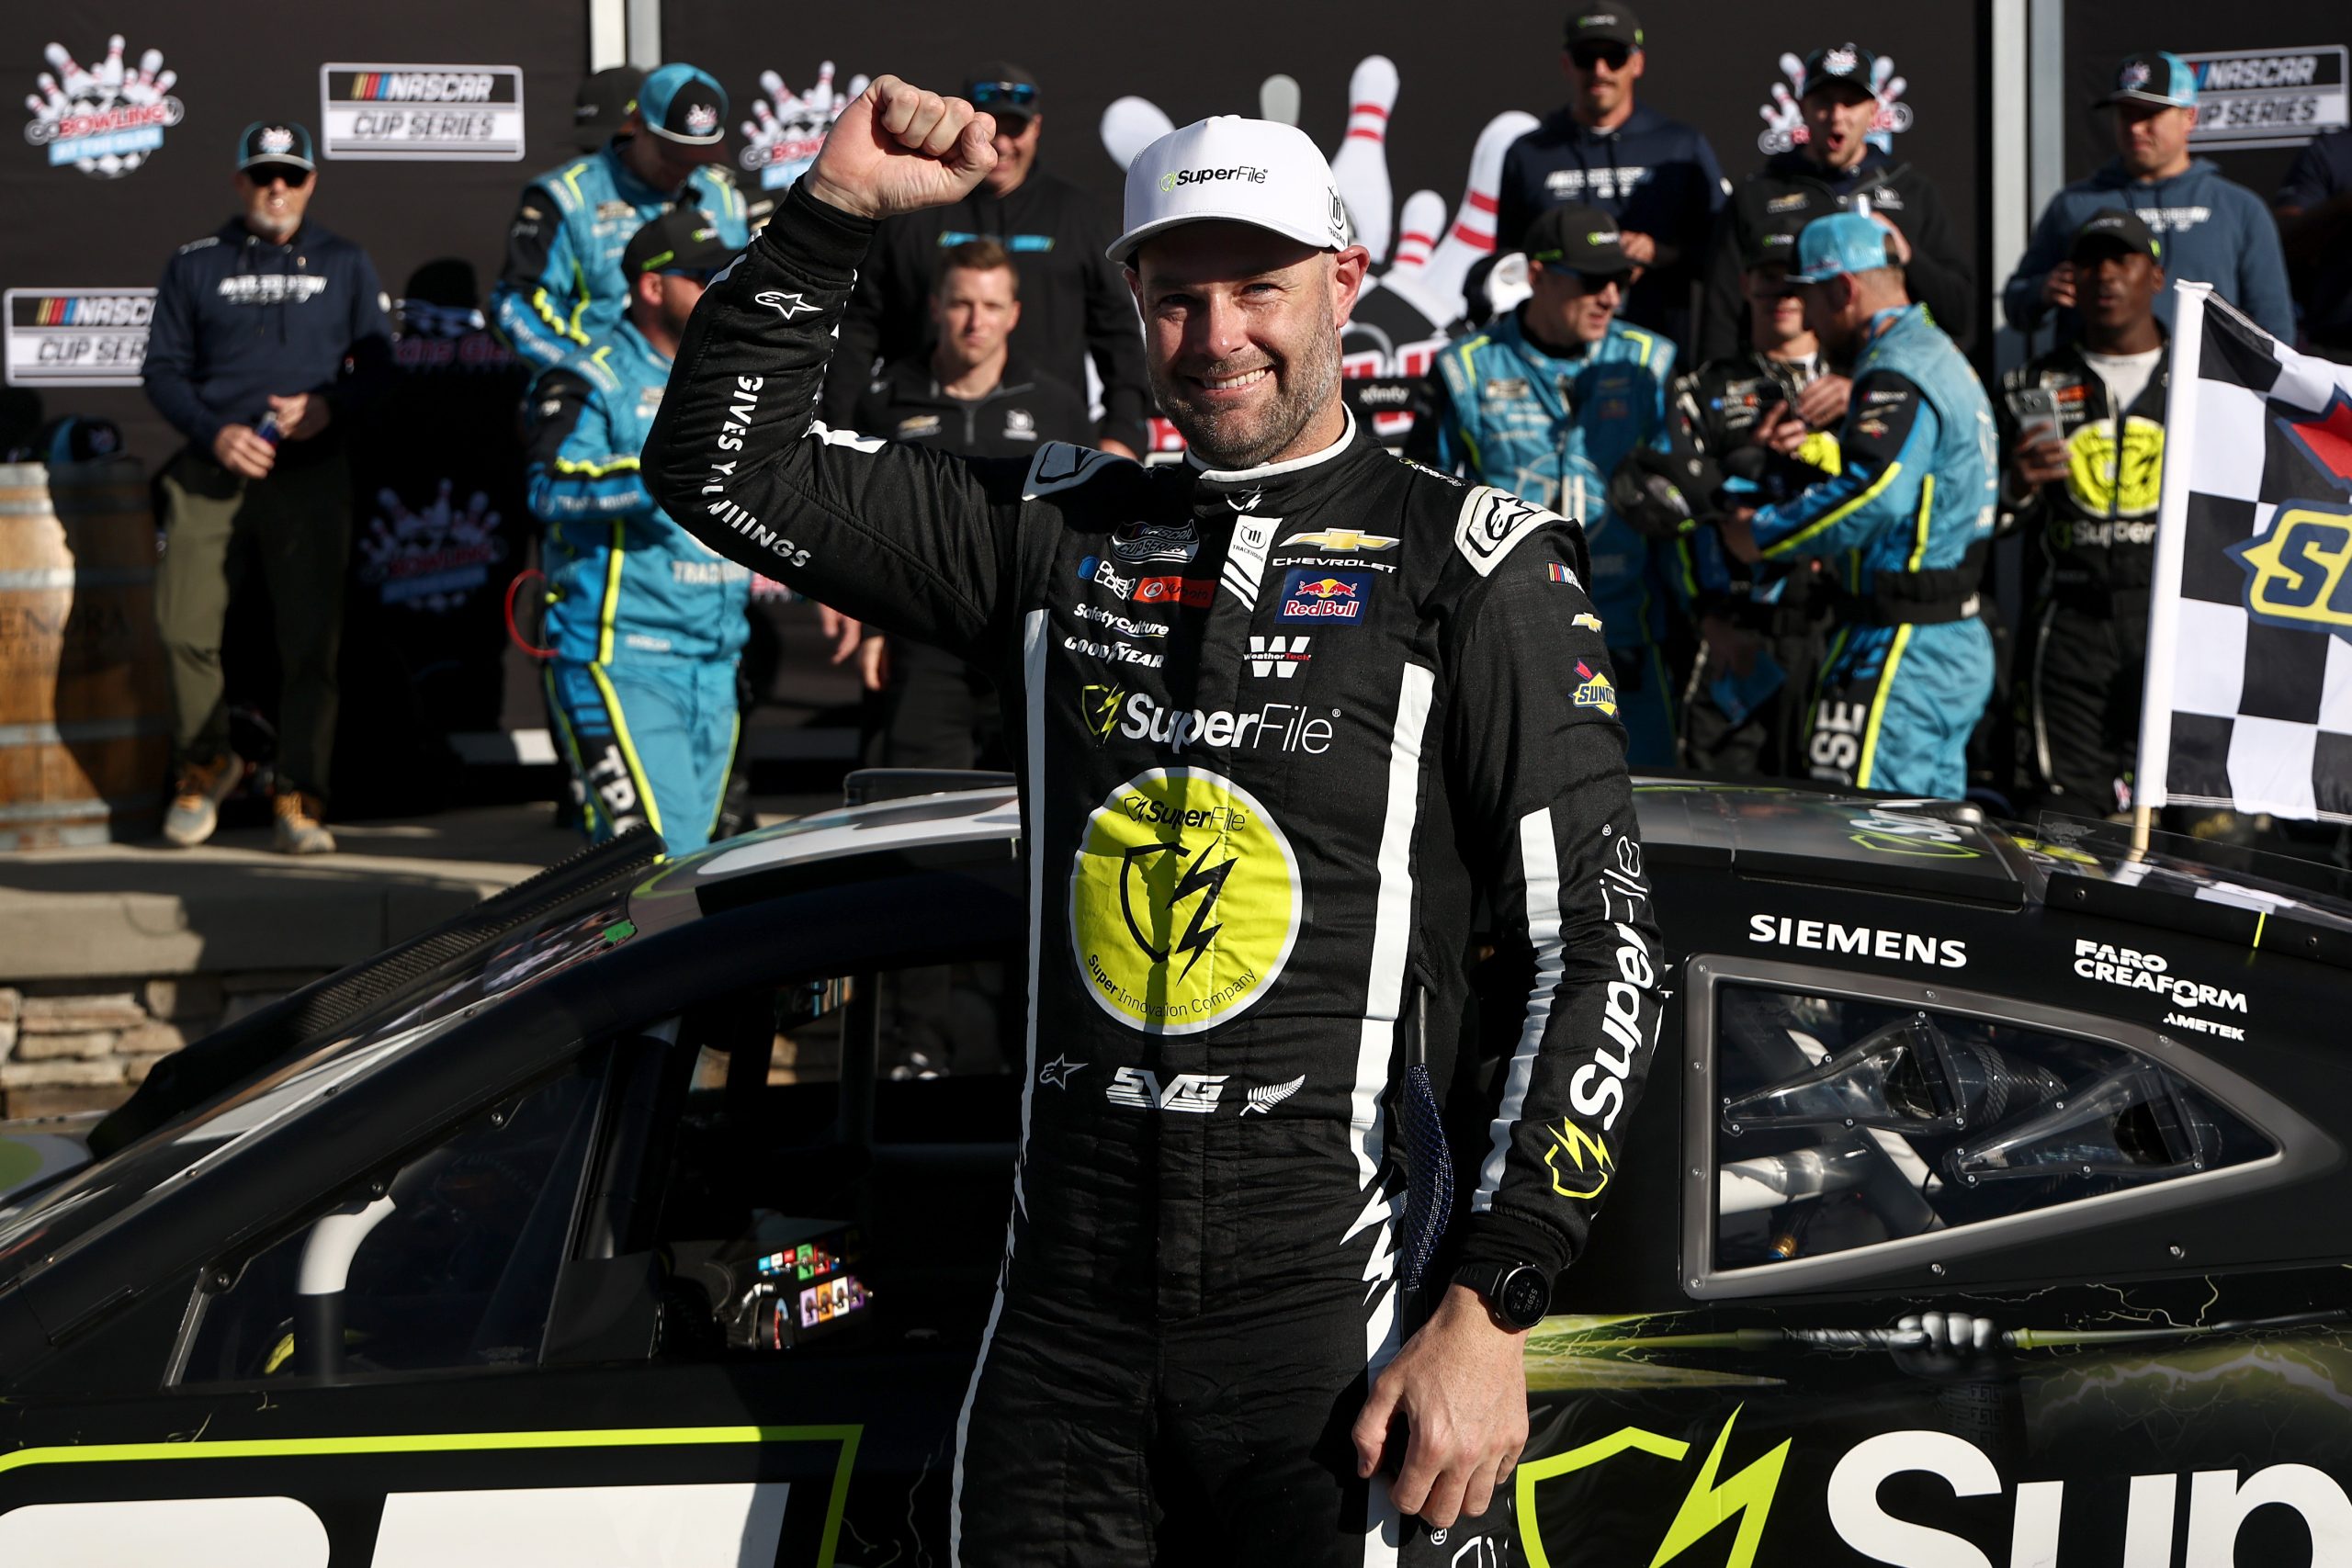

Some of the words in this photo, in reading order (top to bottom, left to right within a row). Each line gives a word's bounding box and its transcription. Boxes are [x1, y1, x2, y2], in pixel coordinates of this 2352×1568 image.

[390, 73, 493, 101] NASCAR
[2204, 57, 2317, 89] NASCAR
[59, 103, 165, 138] BOWLING
[353, 112, 404, 138] CUP
[409, 113, 494, 140] SERIES
[2227, 97, 2316, 127] SERIES
[772, 134, 826, 164] BOW
[1177, 165, 1266, 186] SuperFile
[74, 297, 156, 326] NASC
[39, 337, 90, 363] CUP
[96, 337, 151, 363] SER
[718, 373, 764, 452] GIVES
[702, 460, 737, 496] YU
[1117, 543, 1143, 556] CUP
[1143, 540, 1188, 553] SERIES
[1140, 525, 1193, 540] NASCAR
[2073, 520, 2157, 548] Super
[1272, 557, 1397, 574] CHEVROLET
[1073, 603, 1170, 636] SafetyCulture
[1284, 599, 1319, 616] Red
[1320, 600, 1359, 617] Bull
[1064, 636, 1164, 669] GOODYEAR
[1243, 651, 1311, 662] WeatherTech
[1120, 692, 1333, 754] SuperFile
[1146, 800, 1246, 831] SuperFile
[1748, 914, 1967, 968] SIEMENS
[2075, 938, 2168, 973] FARO
[1088, 953, 1118, 995] Super
[1192, 967, 1257, 1013] Company
[1569, 834, 1655, 1132] SuperFile
[2074, 958, 2248, 1013] CREAFORM
[2163, 1011, 2245, 1042] AMETEK
[1106, 1066, 1230, 1113] SVG
